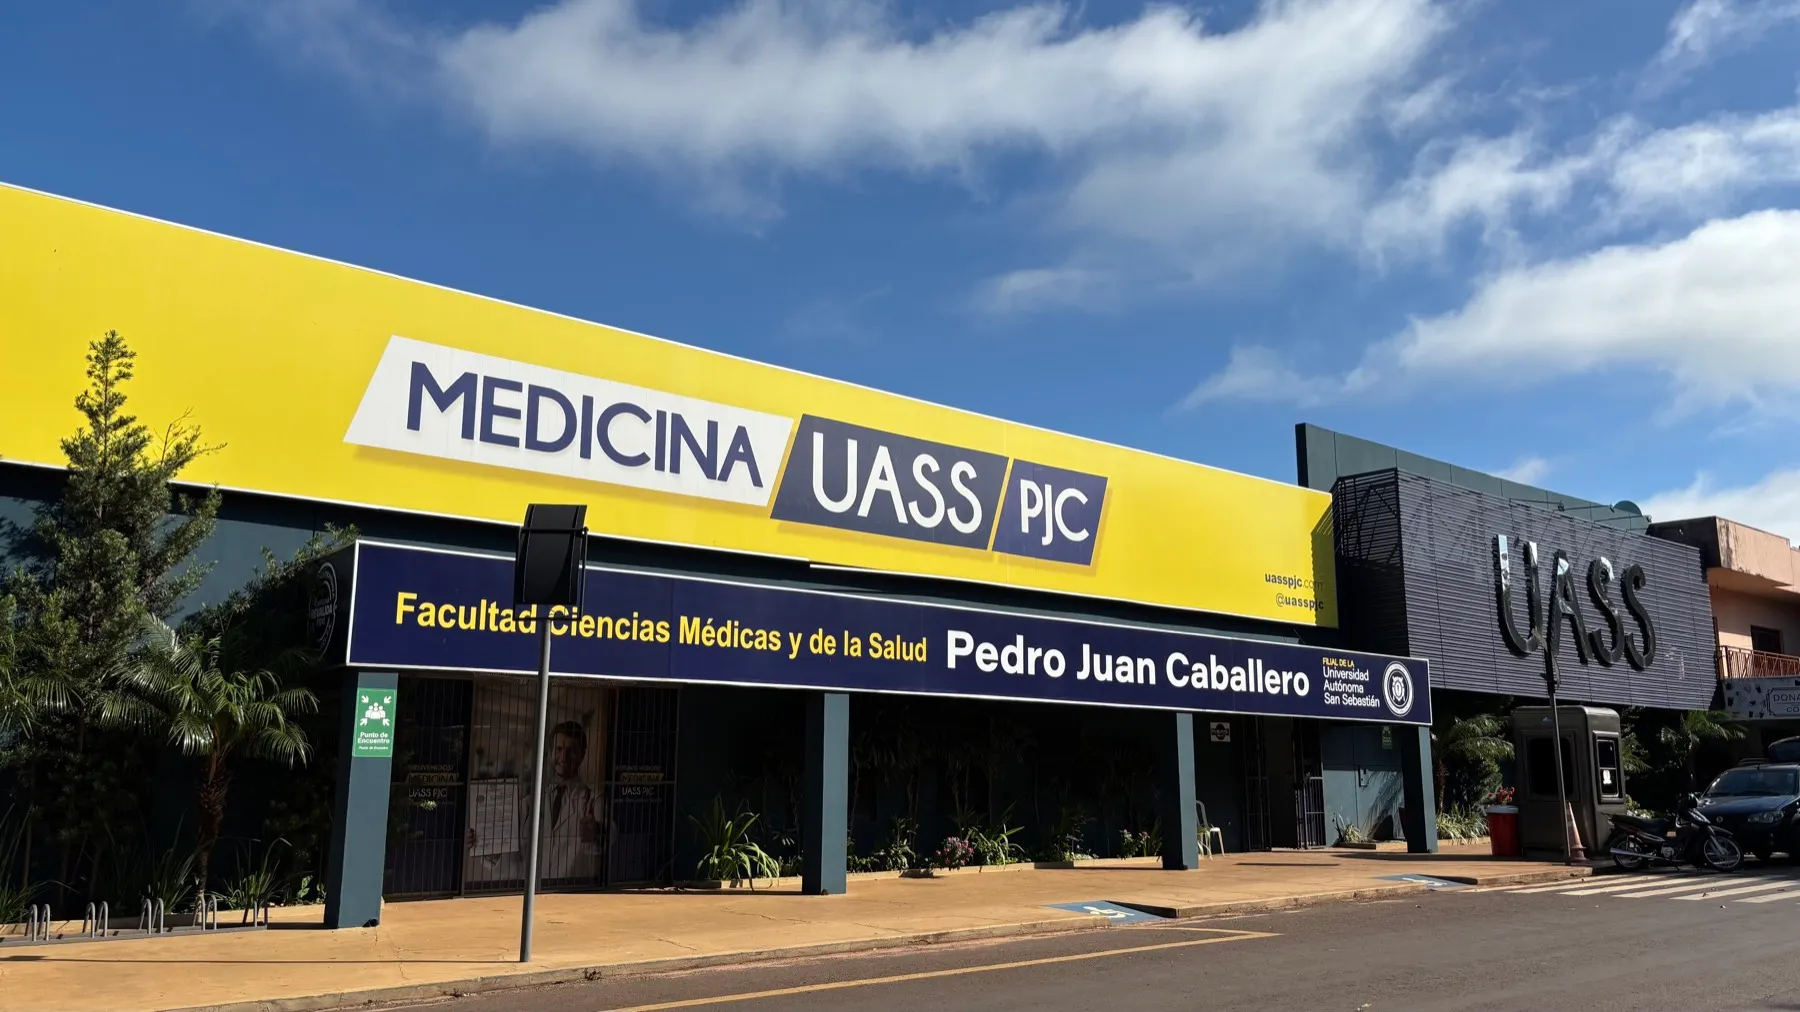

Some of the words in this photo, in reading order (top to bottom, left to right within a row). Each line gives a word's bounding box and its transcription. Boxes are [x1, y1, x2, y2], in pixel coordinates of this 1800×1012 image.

[406, 361, 763, 488] MEDICINA
[812, 431, 982, 534] UASS
[1020, 478, 1090, 546] PJC
[1264, 573, 1324, 590] uasspjc.com
[1275, 592, 1324, 612] @uasspjc
[1492, 534, 1656, 671] UASS
[395, 591, 538, 634] Facultad
[548, 604, 671, 643] Ciencias
[678, 615, 782, 651] Médicas
[788, 631, 803, 660] y
[809, 628, 837, 656] de
[843, 630, 862, 658] la
[868, 632, 927, 662] Salud
[947, 629, 1066, 678] Pedro
[1076, 643, 1157, 685] Juan
[1165, 651, 1311, 697] Caballero
[1322, 657, 1338, 666] FILIAL
[1339, 658, 1347, 667] DE
[1347, 659, 1355, 668] LA
[1323, 666, 1369, 681] Universidad
[1323, 679, 1364, 694] Autónoma
[1324, 693, 1341, 705] San
[1342, 693, 1380, 708] Sebastián
[409, 773, 455, 783] MDICINA
